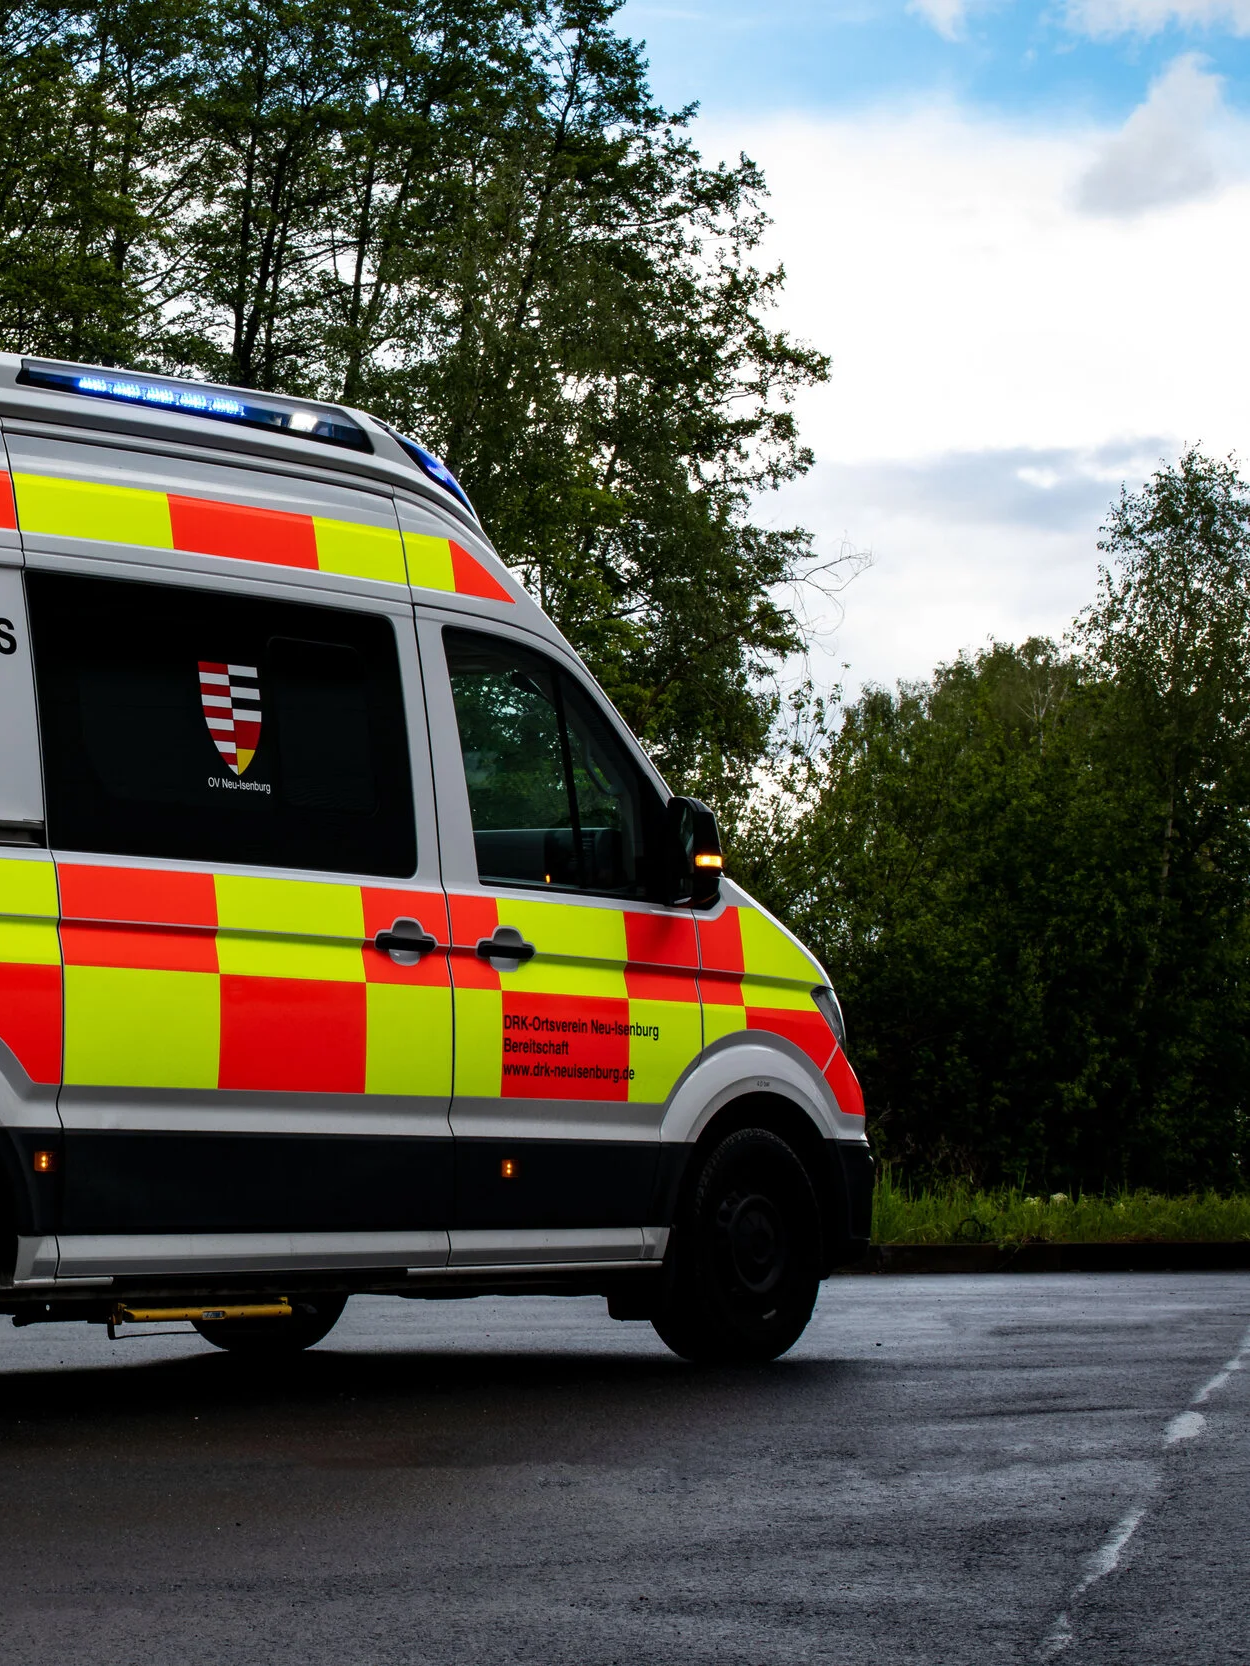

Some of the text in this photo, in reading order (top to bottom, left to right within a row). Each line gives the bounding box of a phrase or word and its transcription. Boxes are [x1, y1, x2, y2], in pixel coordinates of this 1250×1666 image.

[207, 777, 271, 794] OV Neu-Isenburg
[503, 1015, 659, 1041] DRK-Ortsverein Neu-Isenburg
[503, 1038, 569, 1055] Bereitschaft
[503, 1062, 635, 1083] www.drk-neuisenburg.de
